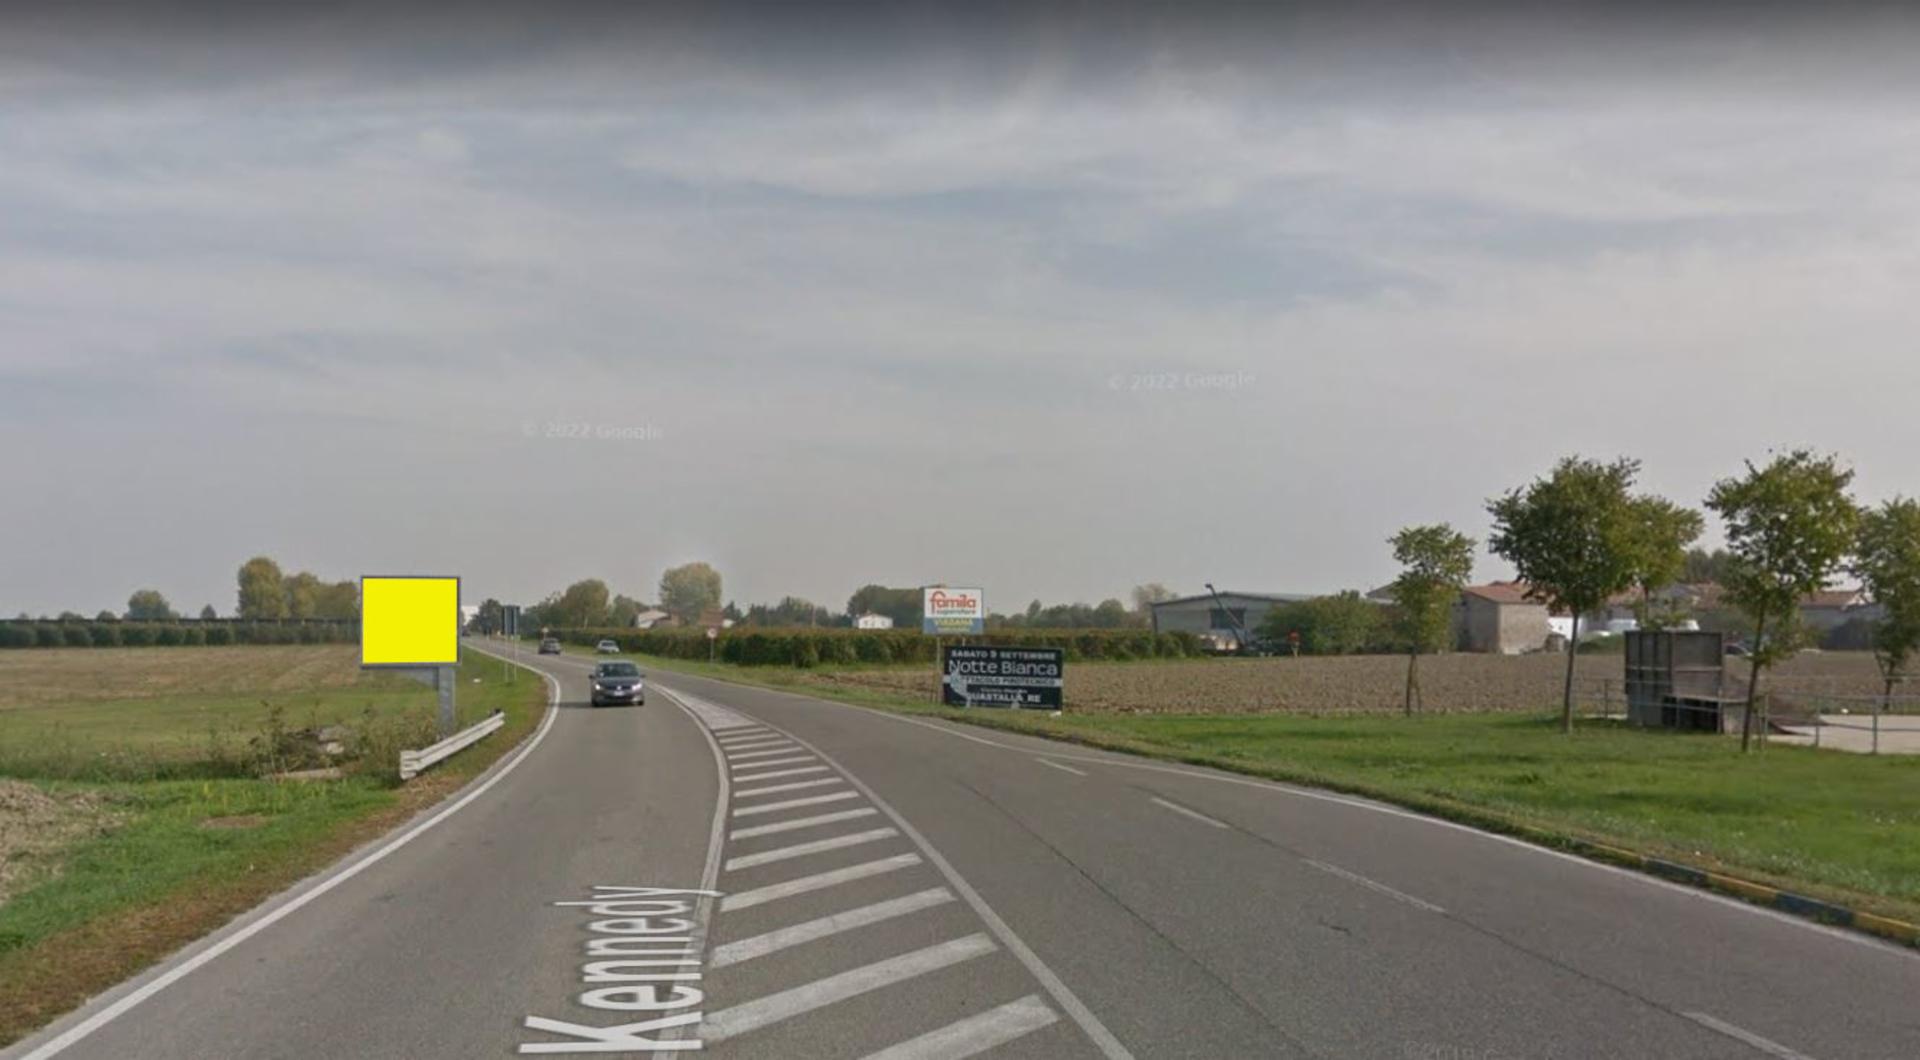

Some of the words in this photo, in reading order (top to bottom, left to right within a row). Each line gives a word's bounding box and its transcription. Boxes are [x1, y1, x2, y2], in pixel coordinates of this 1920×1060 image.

[931, 591, 976, 614] famila
[952, 650, 988, 659] SABATO
[1000, 651, 1055, 661] SETTEMBRE
[949, 660, 999, 674] Notte
[1002, 661, 1058, 676] Bianca
